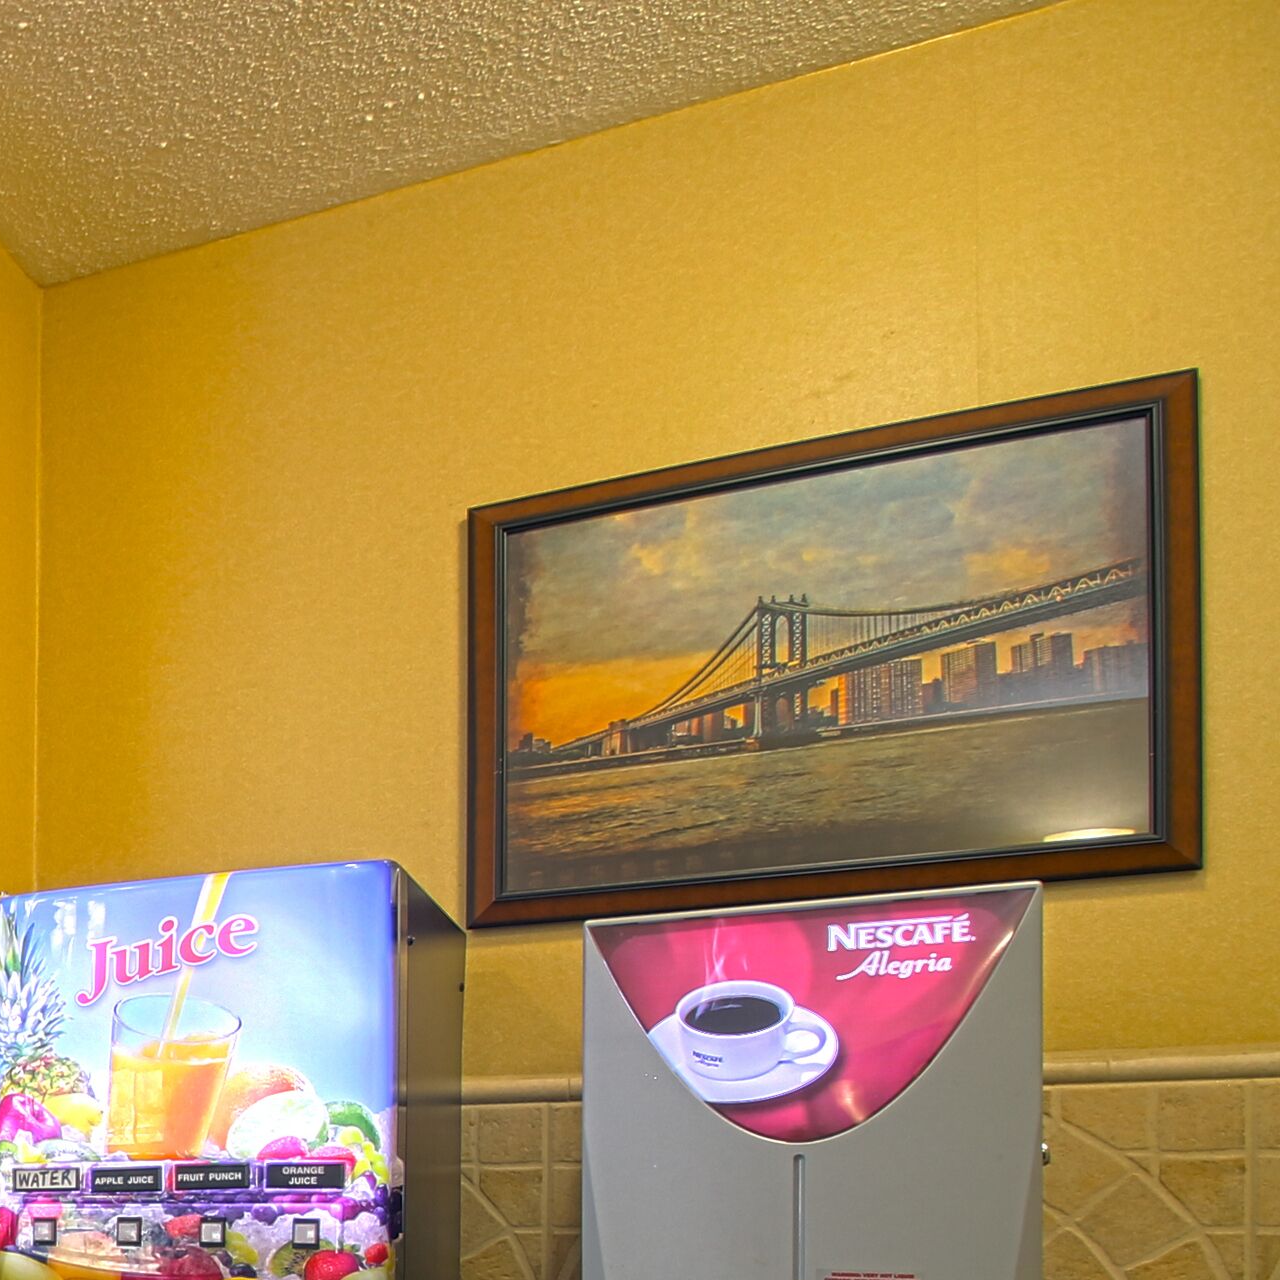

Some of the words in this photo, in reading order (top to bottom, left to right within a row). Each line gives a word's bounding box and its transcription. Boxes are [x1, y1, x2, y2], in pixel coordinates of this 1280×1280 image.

[76, 912, 259, 1006] Juice
[836, 950, 953, 981] Alegria
[282, 1166, 325, 1175] ORANGE
[18, 1168, 72, 1187] WATER
[95, 1176, 124, 1185] APPLE
[127, 1175, 154, 1184] JUICE
[177, 1173, 205, 1182] FRUIT
[209, 1172, 242, 1181] PUNCH
[288, 1176, 318, 1185] JUICE
